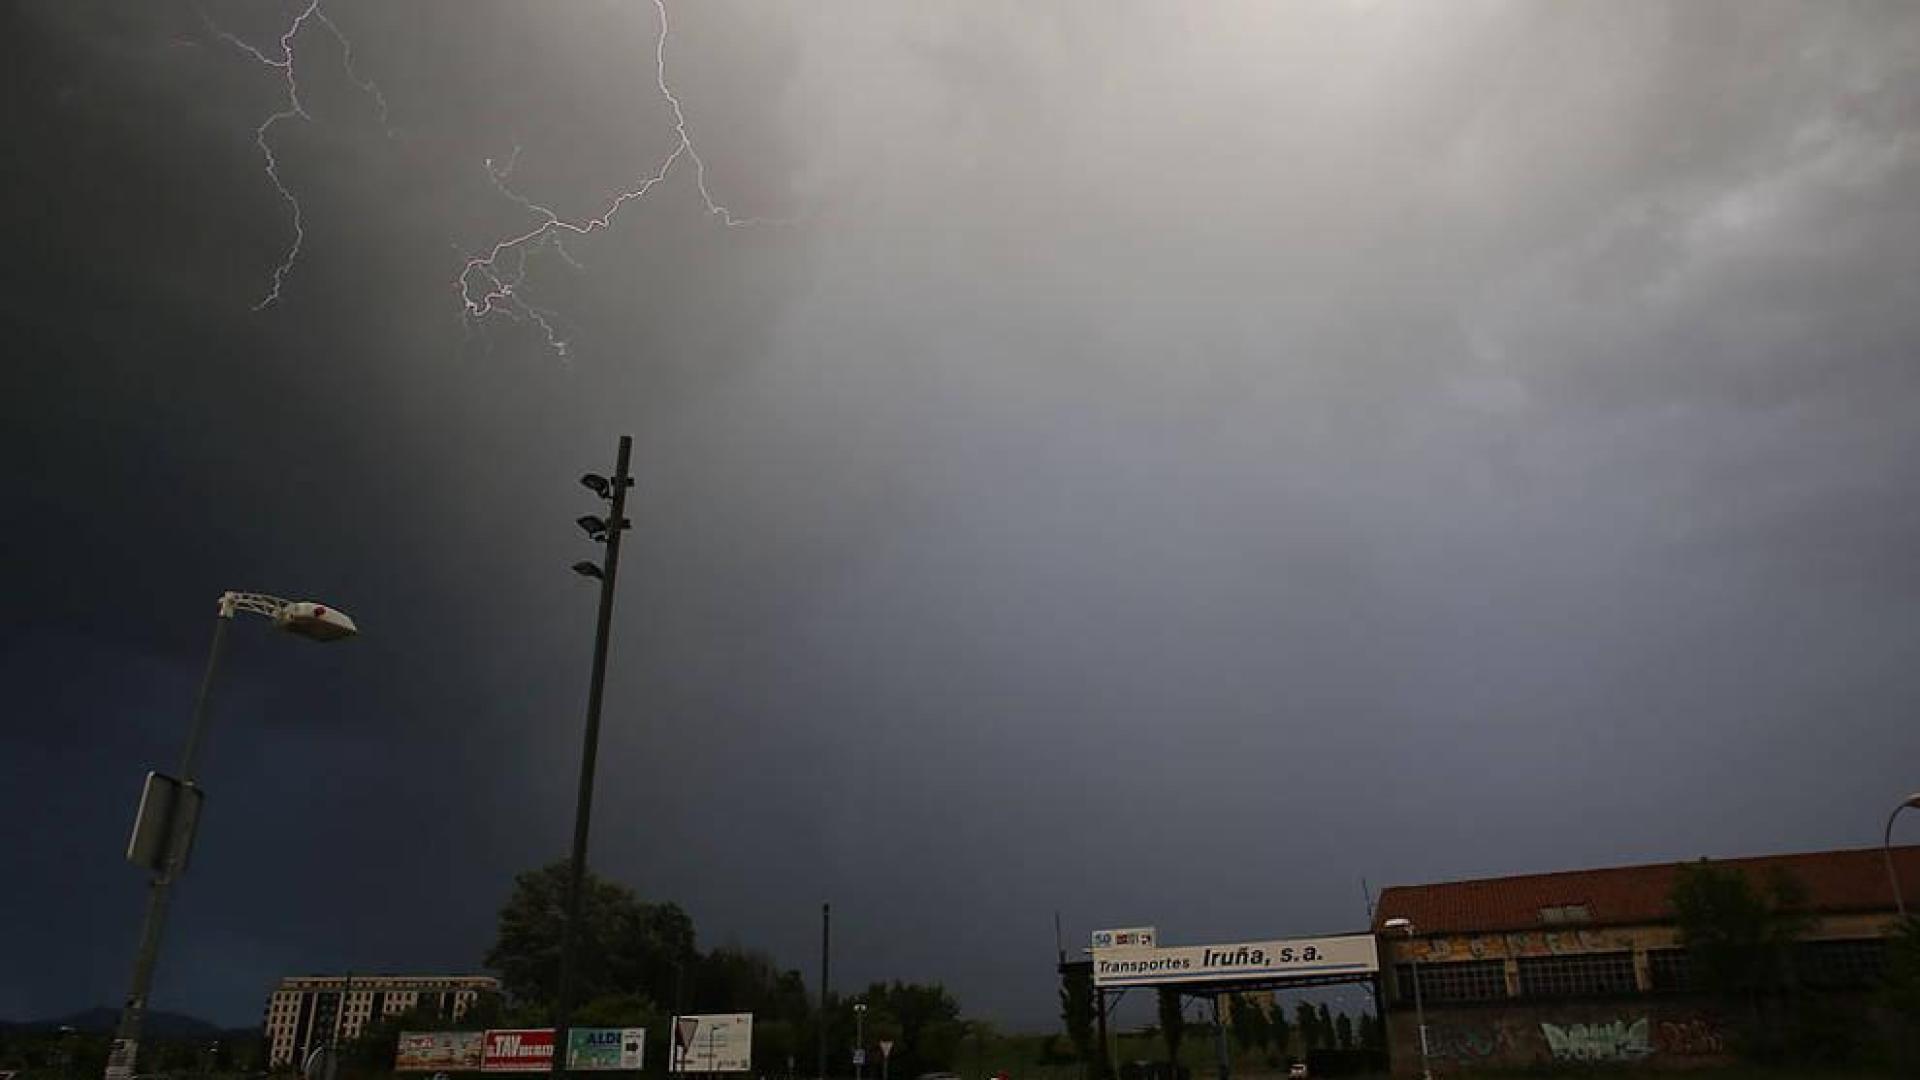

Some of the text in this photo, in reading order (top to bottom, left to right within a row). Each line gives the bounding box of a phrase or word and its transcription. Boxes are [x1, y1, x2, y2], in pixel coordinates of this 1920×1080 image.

[1099, 945, 1323, 973] Transportes Iruña, s.a.
